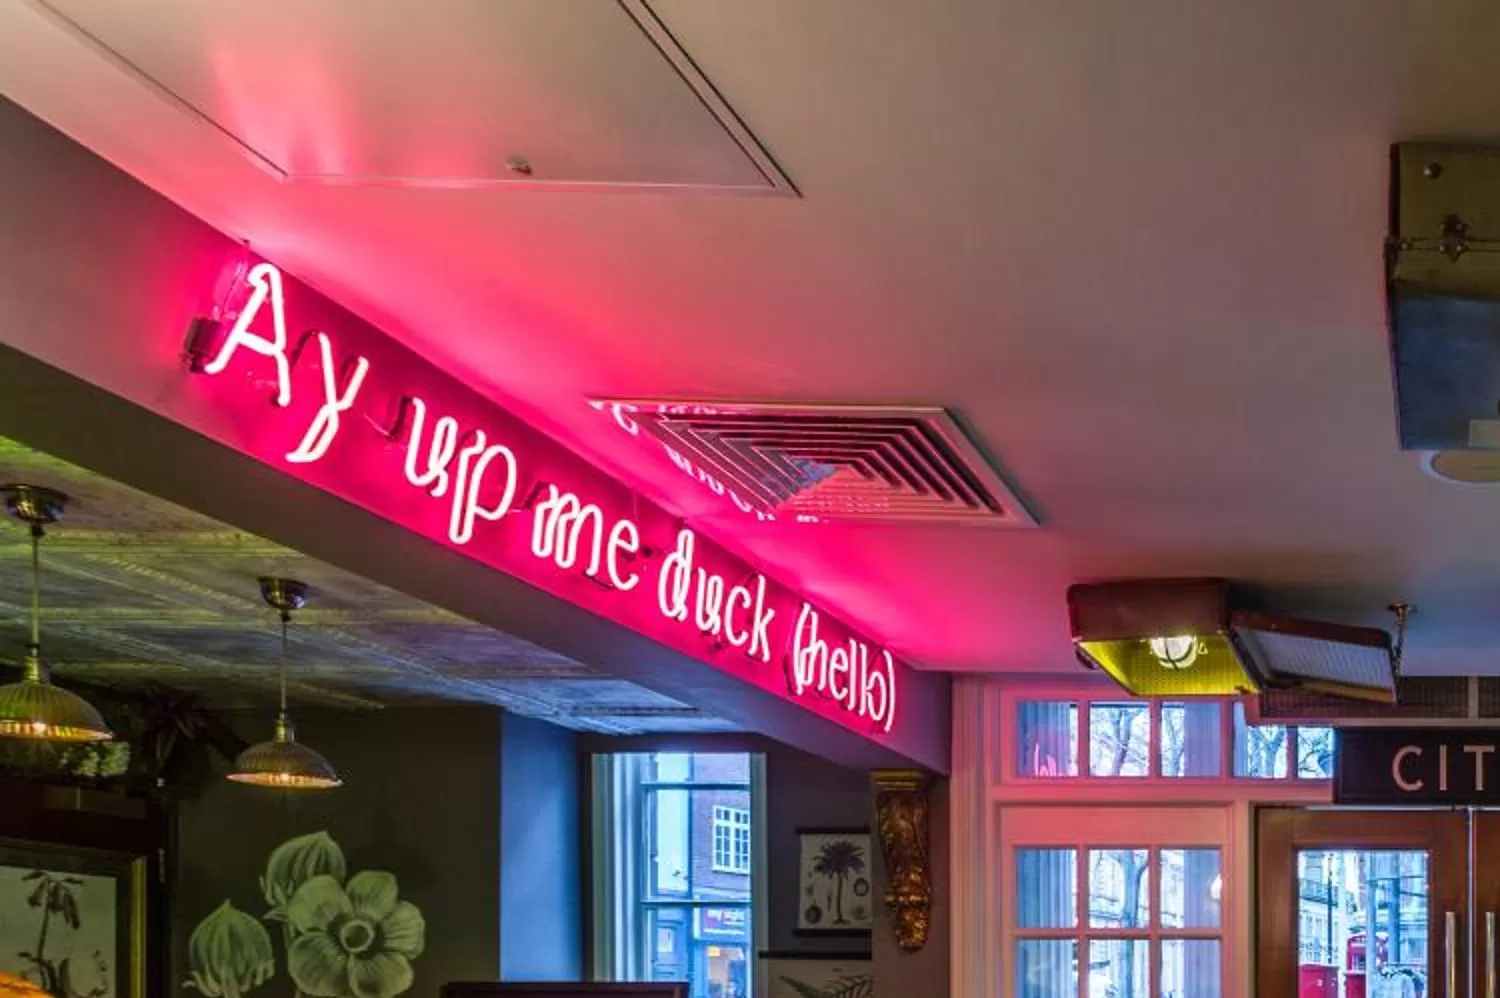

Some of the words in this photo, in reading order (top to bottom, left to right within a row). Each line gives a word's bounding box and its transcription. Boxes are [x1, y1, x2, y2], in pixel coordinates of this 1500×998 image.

[204, 262, 369, 463] Ay
[404, 397, 517, 544] up
[532, 482, 639, 590] me
[659, 529, 775, 663] duck
[794, 603, 897, 732] (hello)
